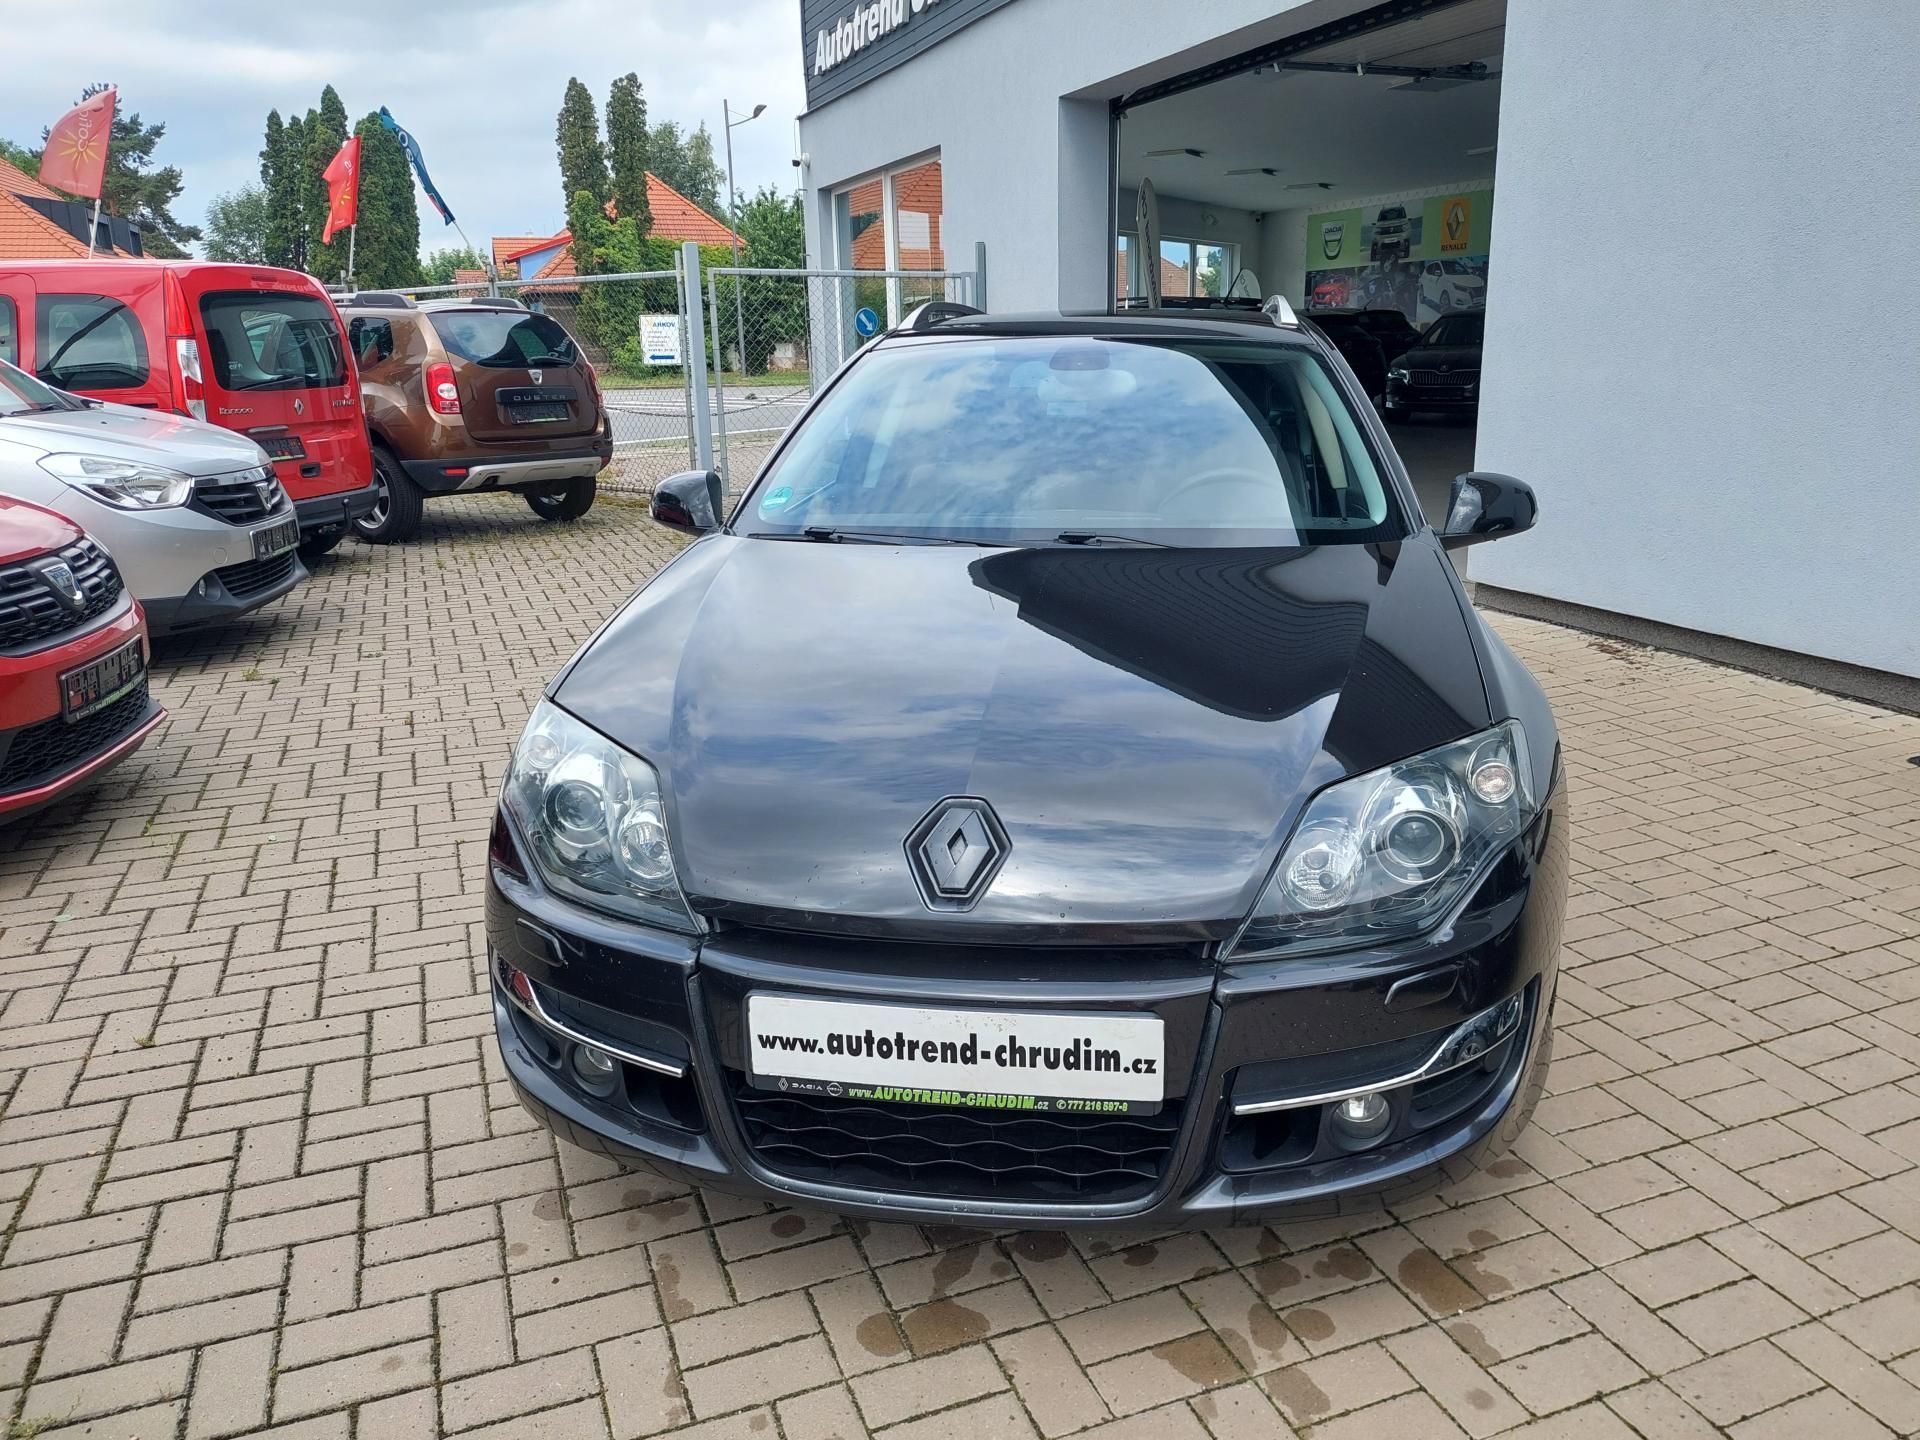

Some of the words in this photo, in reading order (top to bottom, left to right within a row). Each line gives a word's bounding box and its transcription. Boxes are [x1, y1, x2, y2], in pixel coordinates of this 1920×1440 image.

[814, 0, 909, 76] Autotrend
[1440, 242, 1467, 252] RENAULT
[757, 1029, 1157, 1074] www.autotrend-chrudim.cz
[1067, 1100, 1084, 1110] 777
